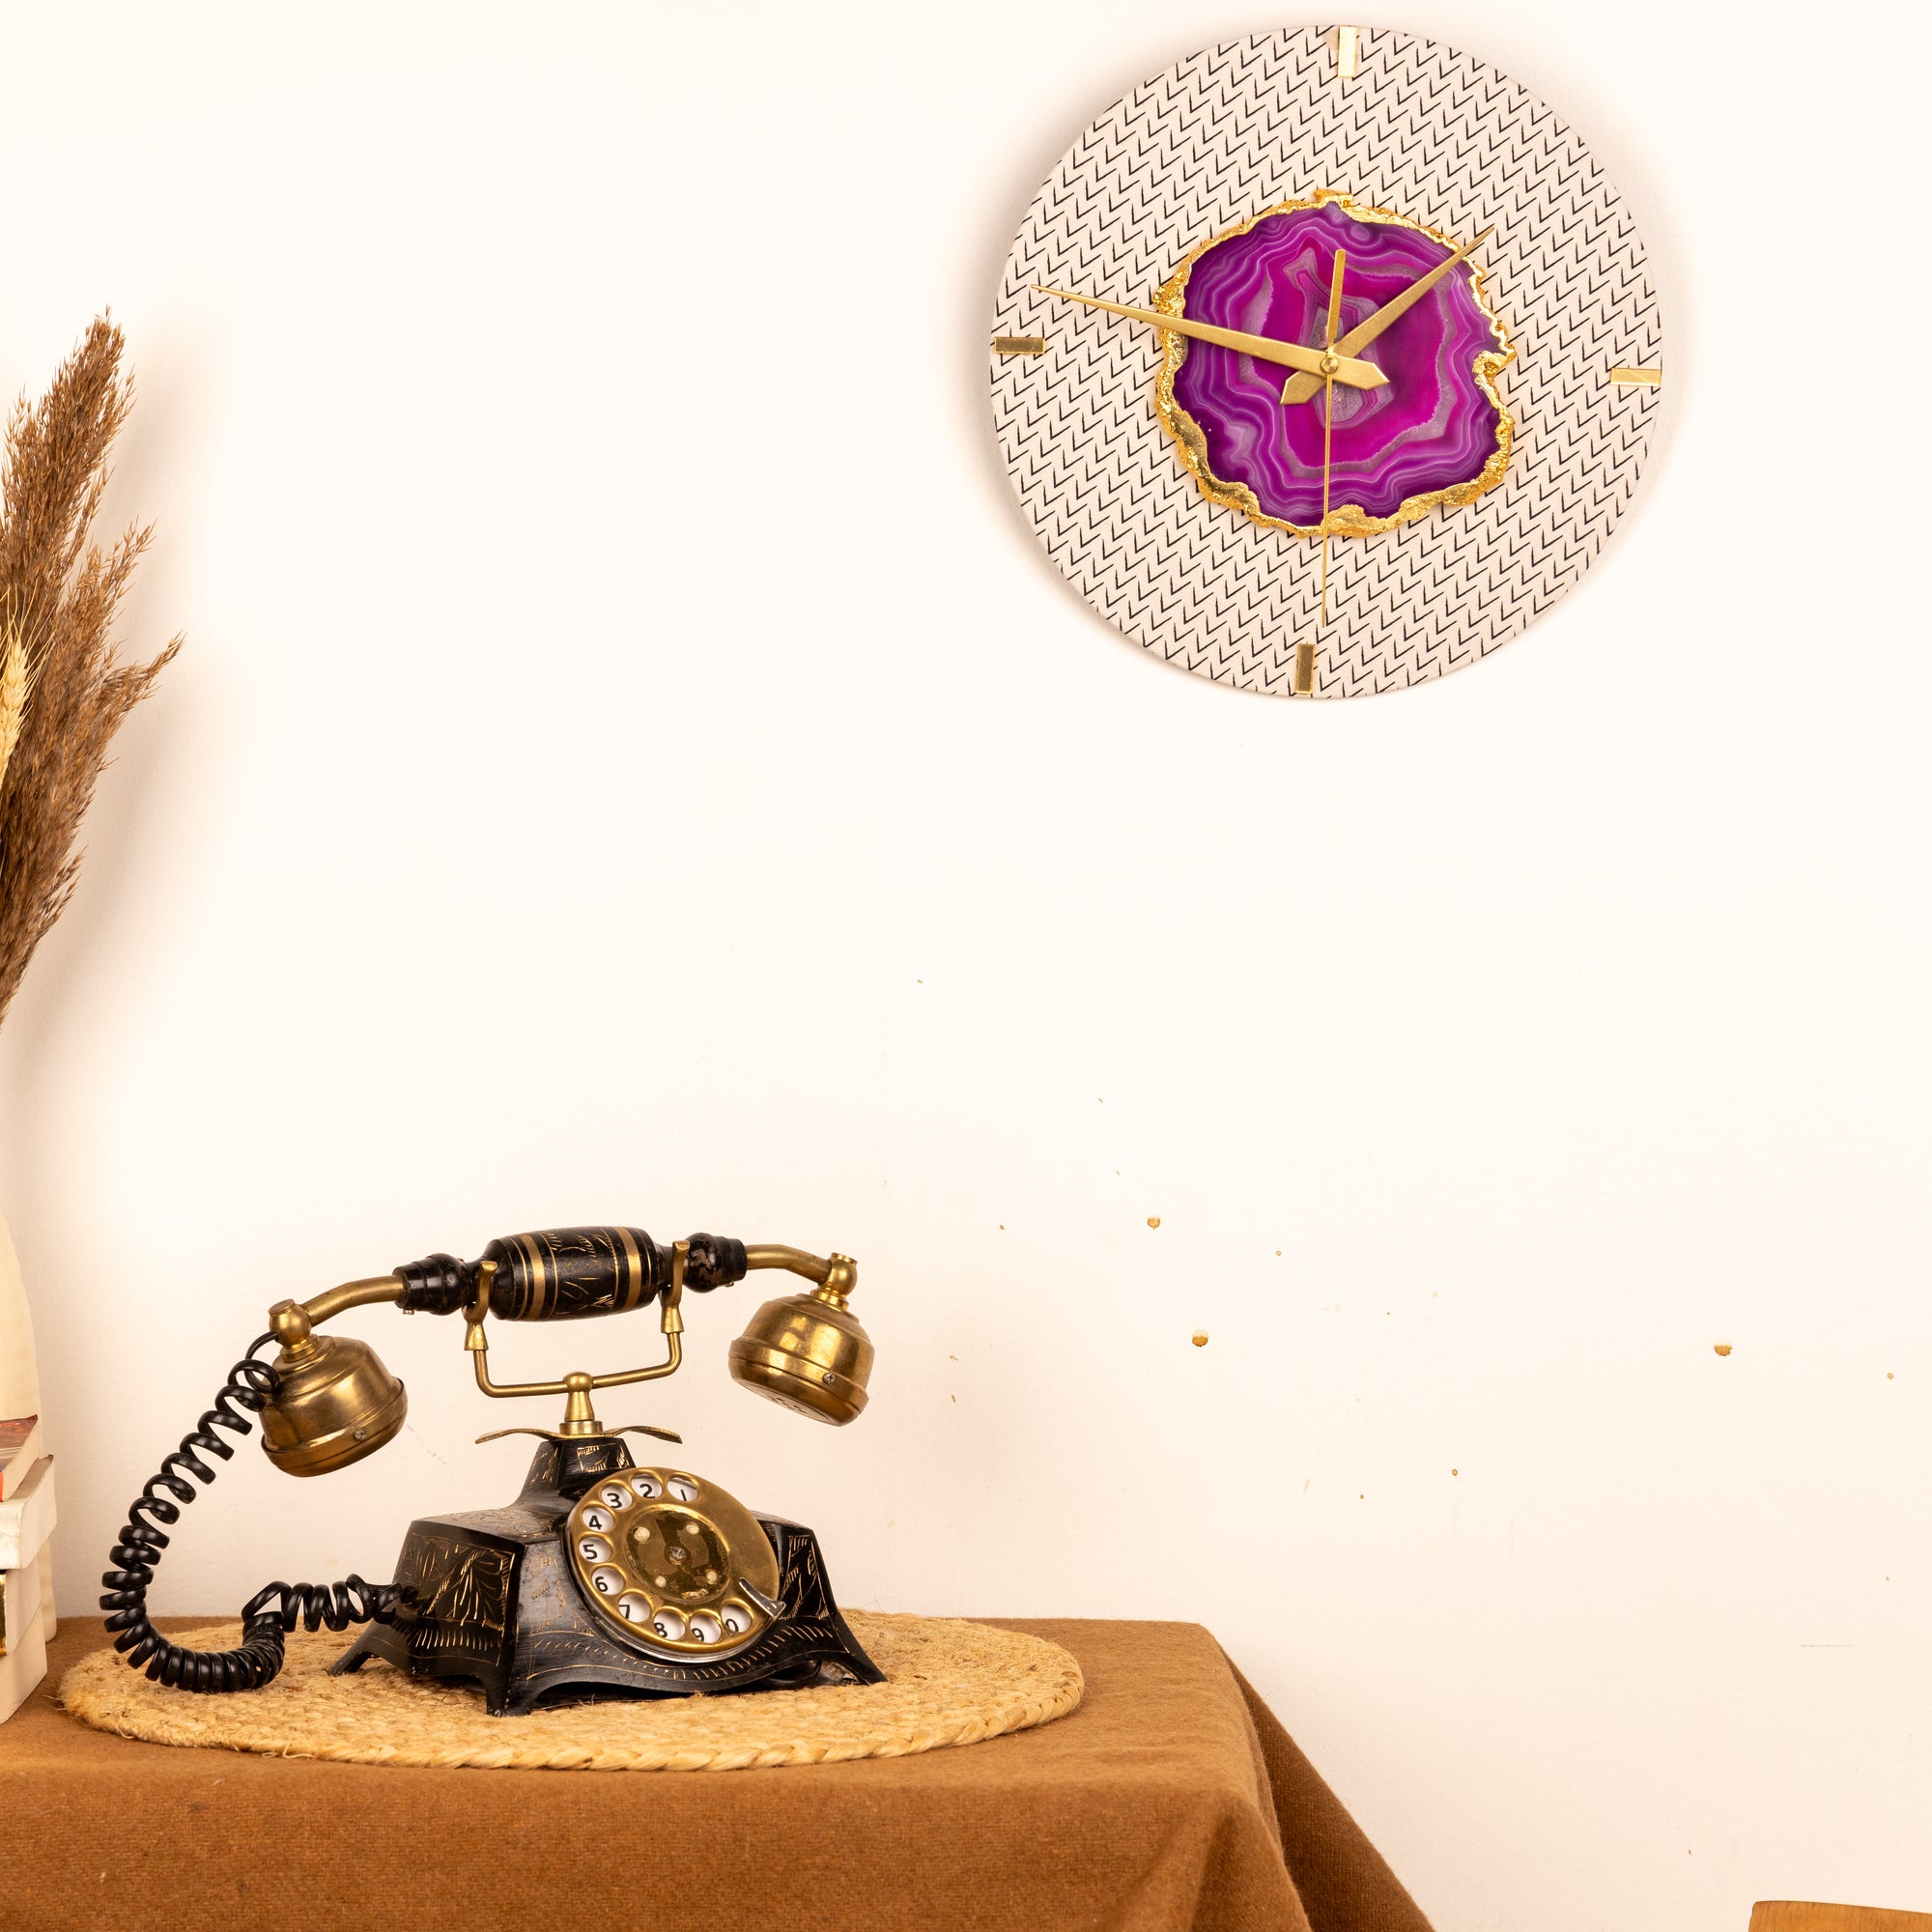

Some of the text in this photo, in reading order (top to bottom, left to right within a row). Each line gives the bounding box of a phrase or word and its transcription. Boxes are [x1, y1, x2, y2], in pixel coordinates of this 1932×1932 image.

[639, 1484, 655, 1498] 2
[680, 1490, 688, 1501] 1
[607, 1492, 622, 1509] 3
[588, 1516, 602, 1530] 4
[582, 1544, 598, 1559] 5
[594, 1576, 609, 1592] 6
[618, 1604, 630, 1620] 7
[654, 1622, 668, 1638] 8
[724, 1618, 739, 1633] 0
[693, 1627, 705, 1642] 9
